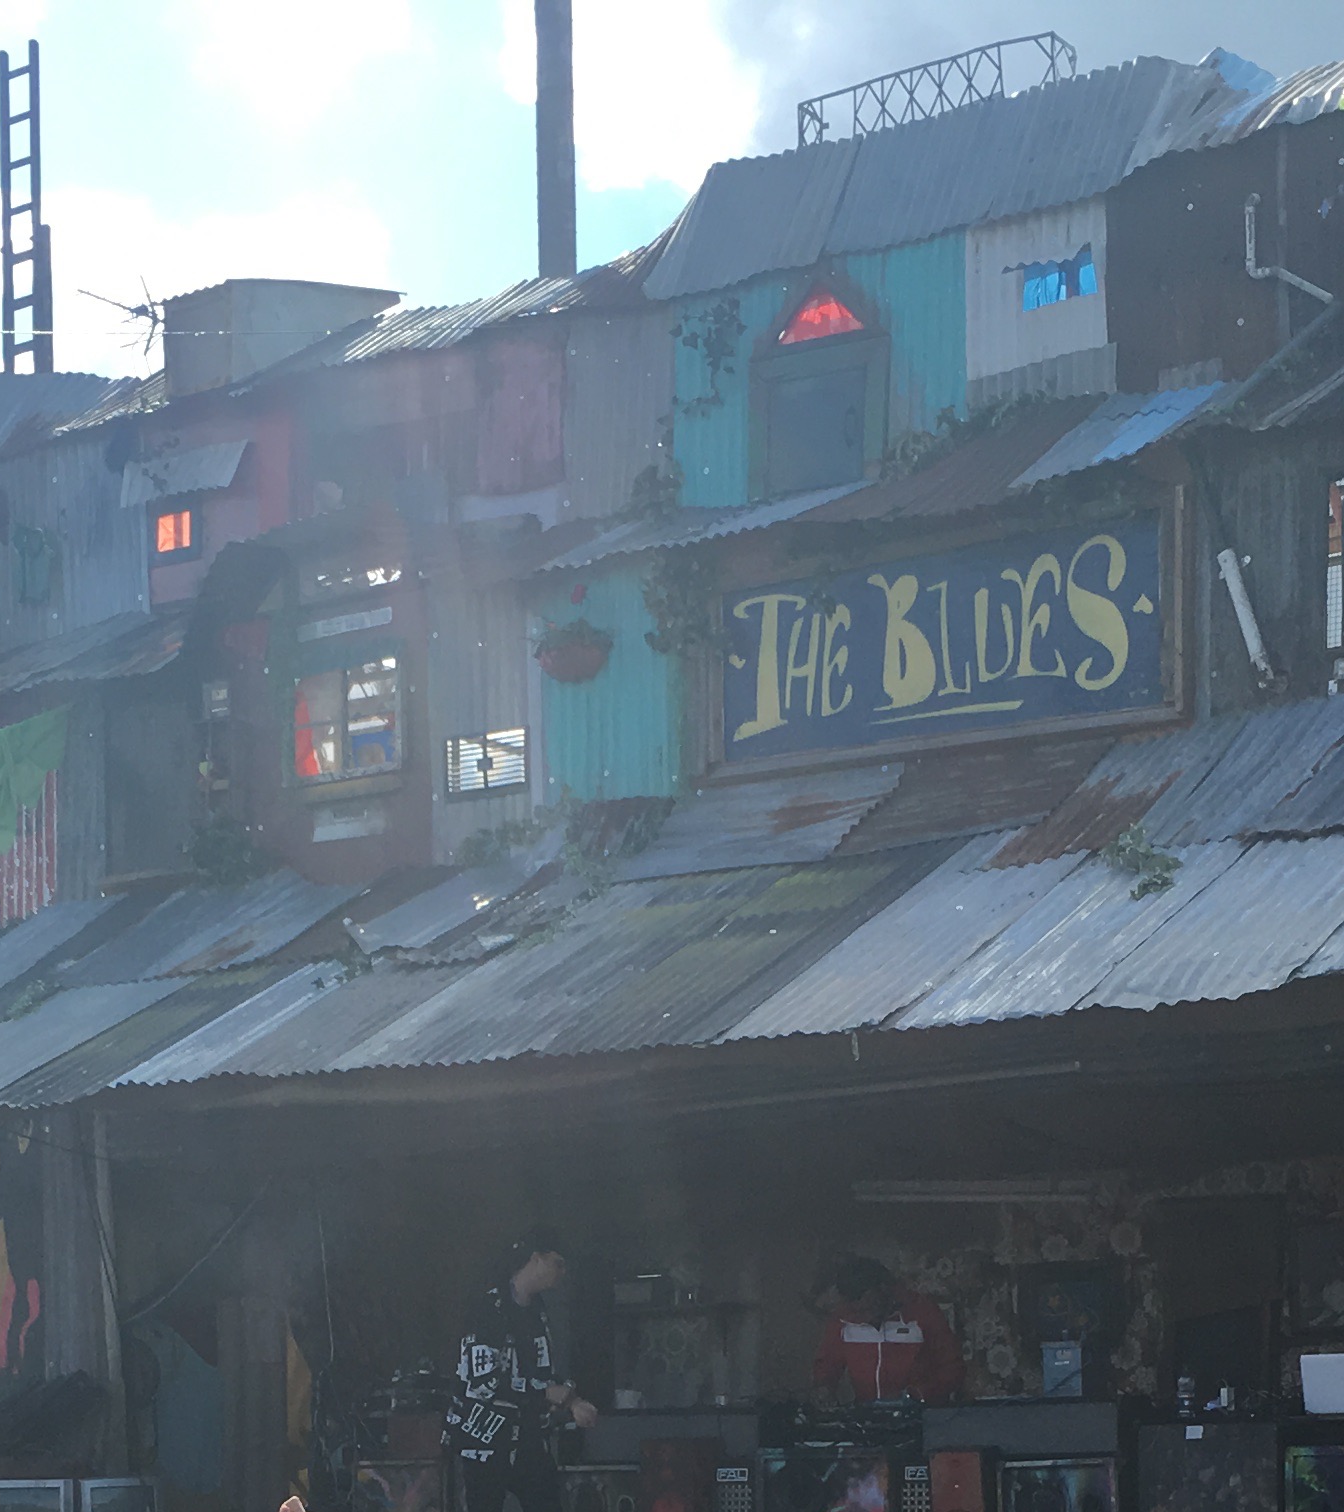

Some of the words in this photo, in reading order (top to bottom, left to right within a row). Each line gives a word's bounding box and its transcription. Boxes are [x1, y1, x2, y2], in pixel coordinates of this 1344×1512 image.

[733, 593, 854, 743] THE
[867, 534, 1129, 714] BLUES
[719, 1469, 747, 1480] FAL
[908, 1468, 928, 1479] FA
